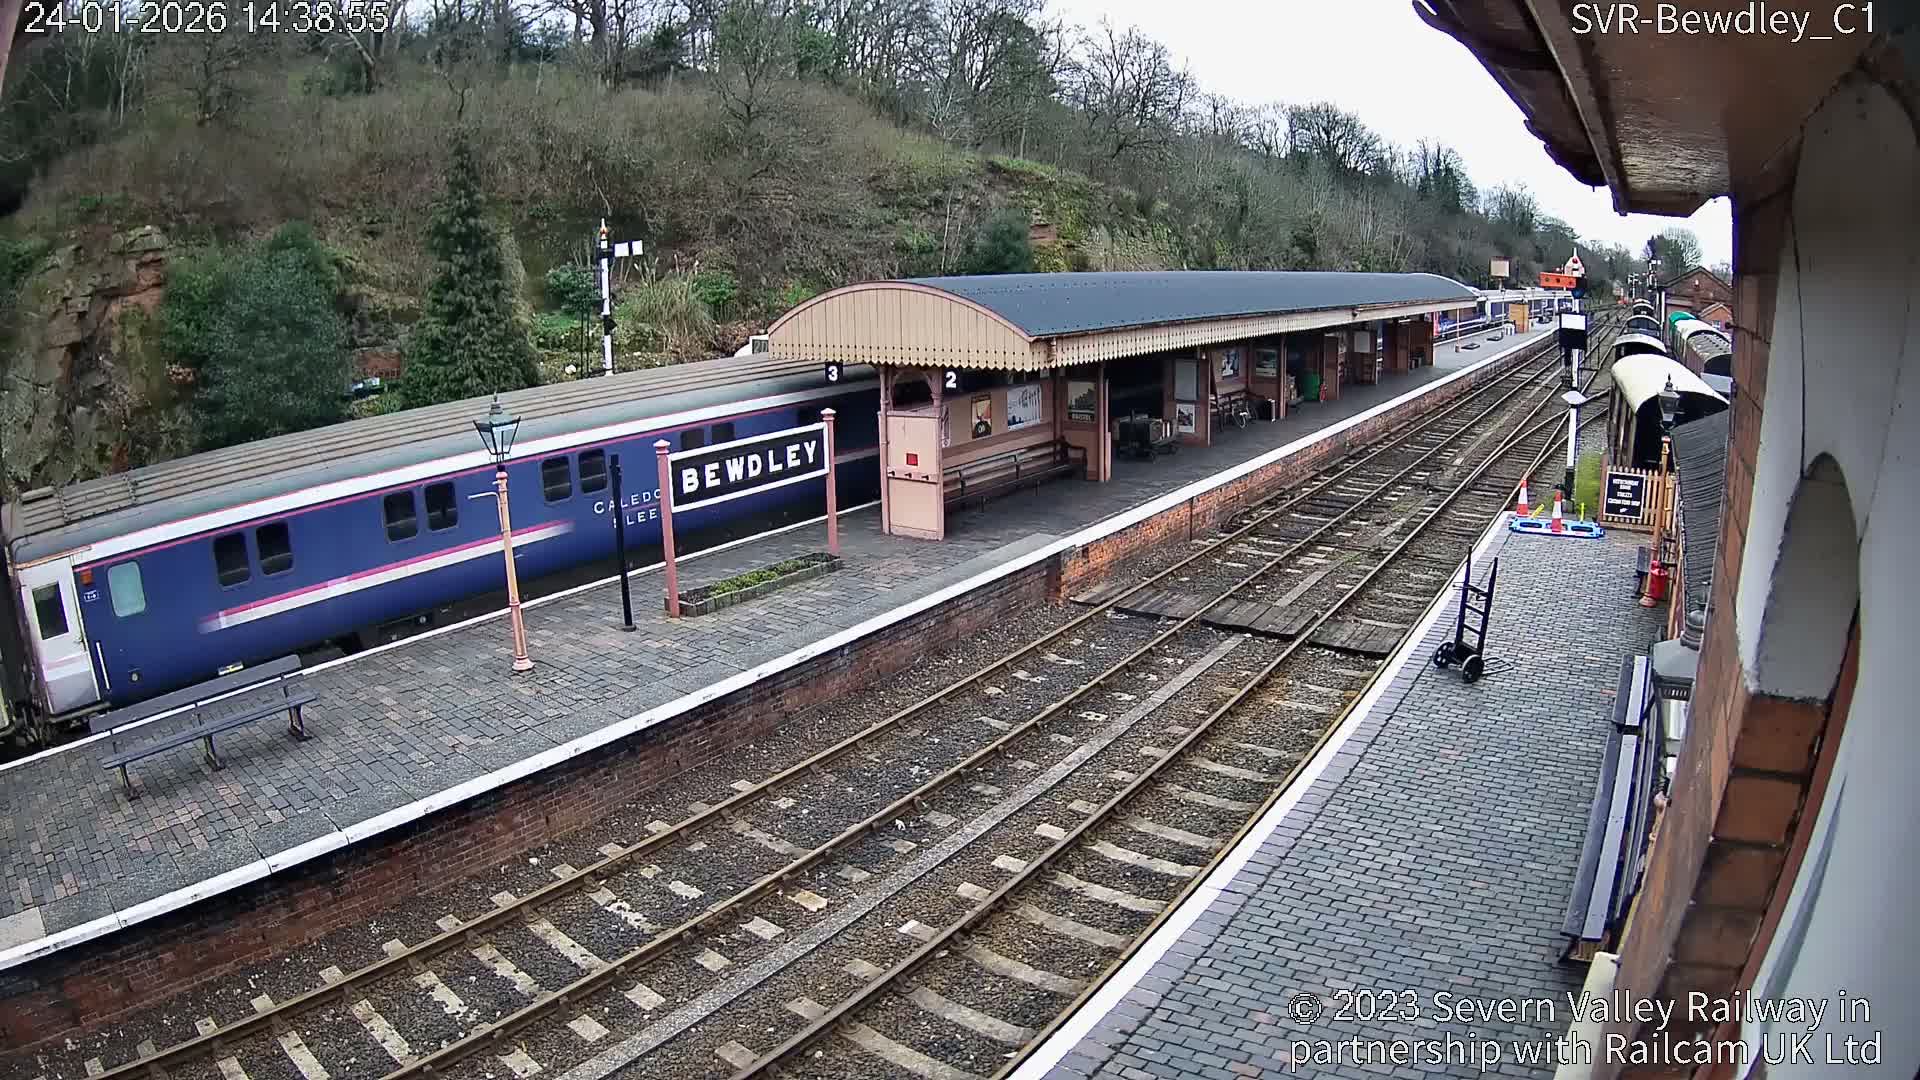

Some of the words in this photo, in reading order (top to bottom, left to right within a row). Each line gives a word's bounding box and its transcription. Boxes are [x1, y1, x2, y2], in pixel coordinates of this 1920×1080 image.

[828, 365, 838, 381] 3
[945, 371, 957, 388] 2
[681, 440, 817, 494] BEWDLEY
[613, 508, 658, 529] LEE
